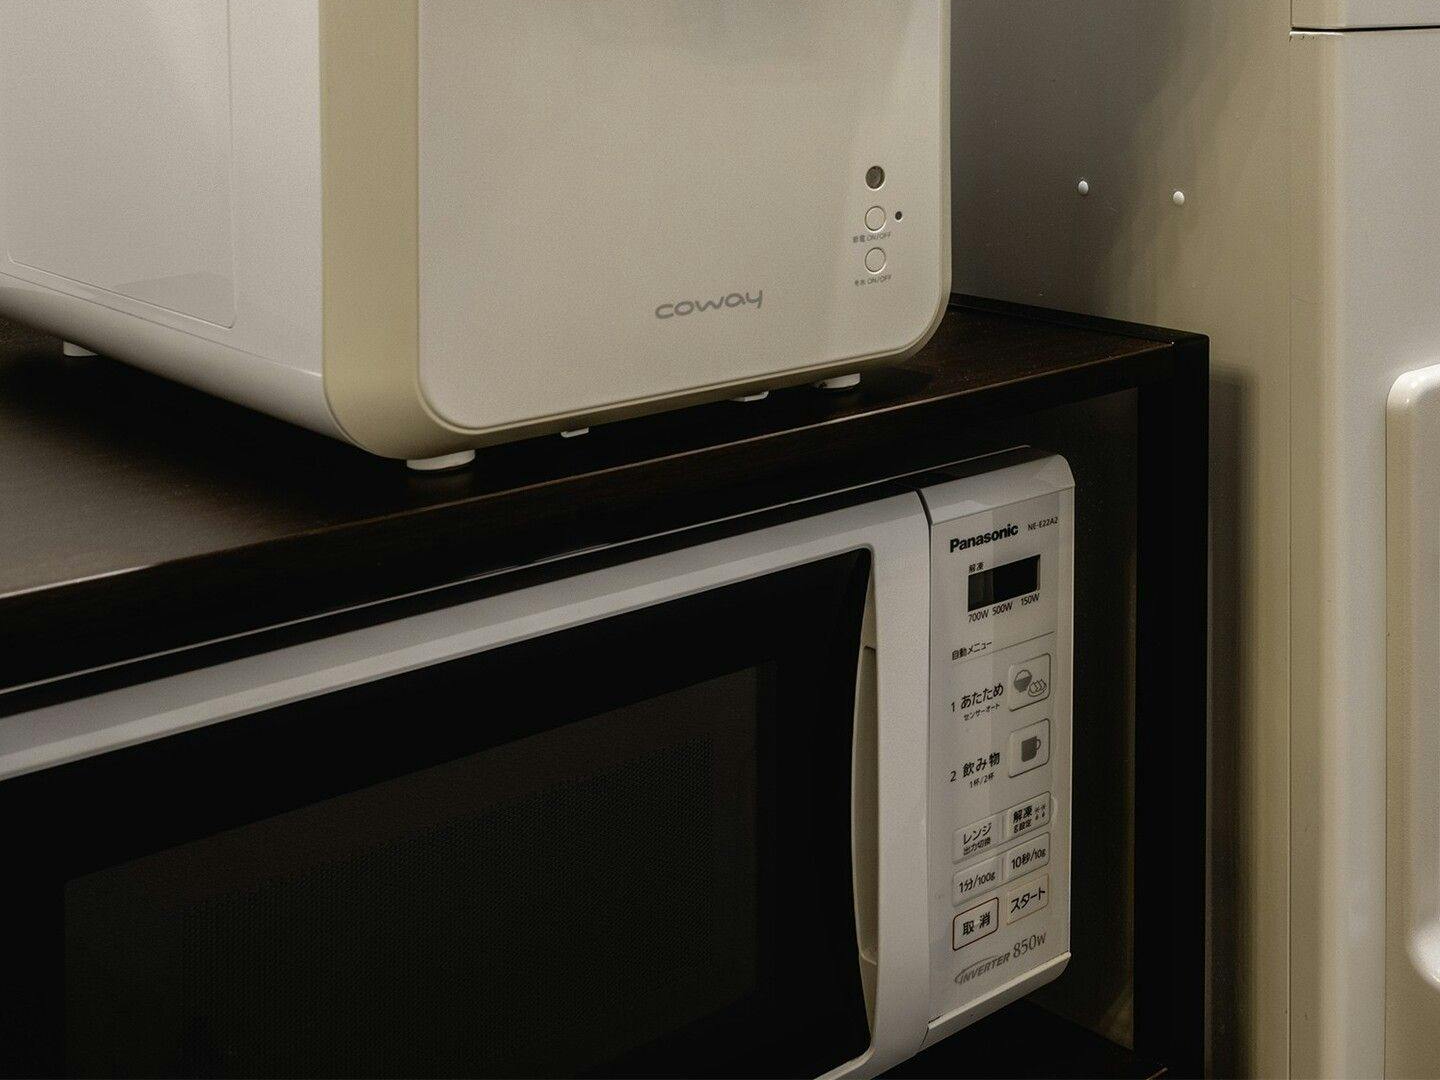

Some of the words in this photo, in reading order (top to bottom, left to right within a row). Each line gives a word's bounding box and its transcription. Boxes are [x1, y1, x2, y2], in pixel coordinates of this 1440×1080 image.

[655, 290, 763, 319] coway
[950, 523, 1019, 553] Panasonic
[968, 609, 990, 623] 700W
[992, 602, 1014, 616] 500W
[1020, 593, 1040, 607] 150W
[952, 640, 992, 660] 自動メニュー
[961, 682, 1004, 710] あたため
[964, 703, 1000, 721] センサーオート
[950, 771, 957, 783] 2
[962, 752, 1000, 778] 飲み物
[963, 823, 992, 845] レンジ
[1011, 848, 1046, 869] 10秒/10g
[959, 872, 996, 893] 1分/100g
[1011, 887, 1046, 913] スタート
